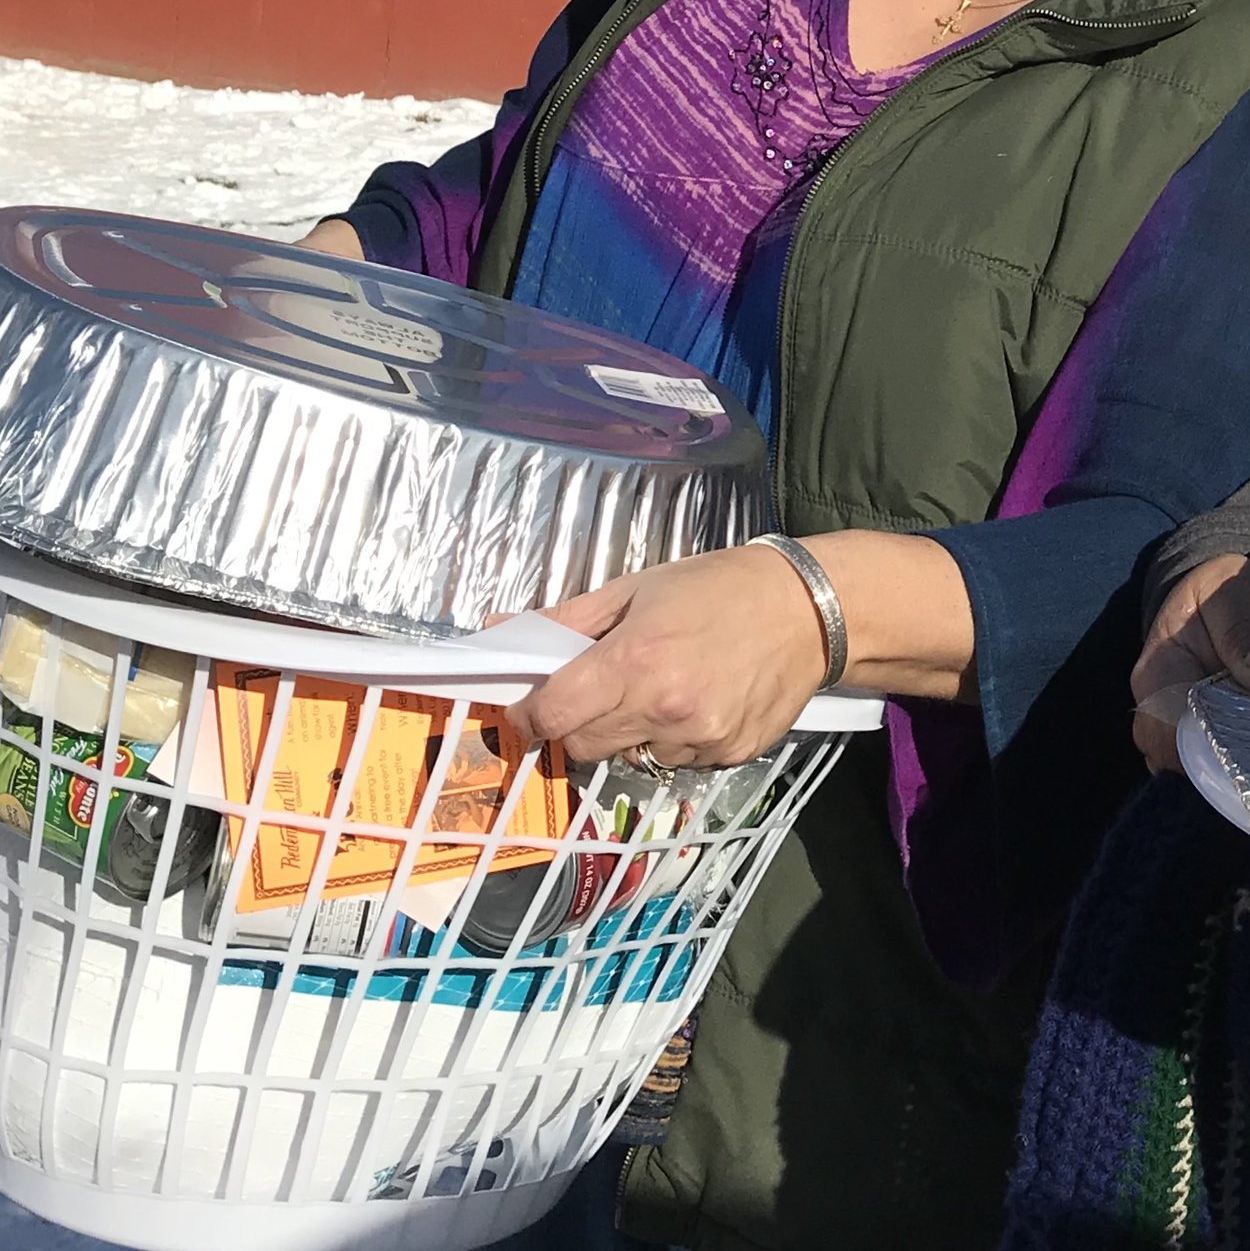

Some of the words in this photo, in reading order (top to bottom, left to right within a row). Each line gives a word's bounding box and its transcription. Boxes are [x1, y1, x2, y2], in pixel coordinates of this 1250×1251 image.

[365, 765, 374, 776] to
[380, 764, 390, 791] event
[271, 766, 295, 799] Hill
[77, 782, 98, 823] onte
[383, 793, 392, 813] free
[585, 865, 594, 876] 14
[583, 877, 594, 890] OZ
